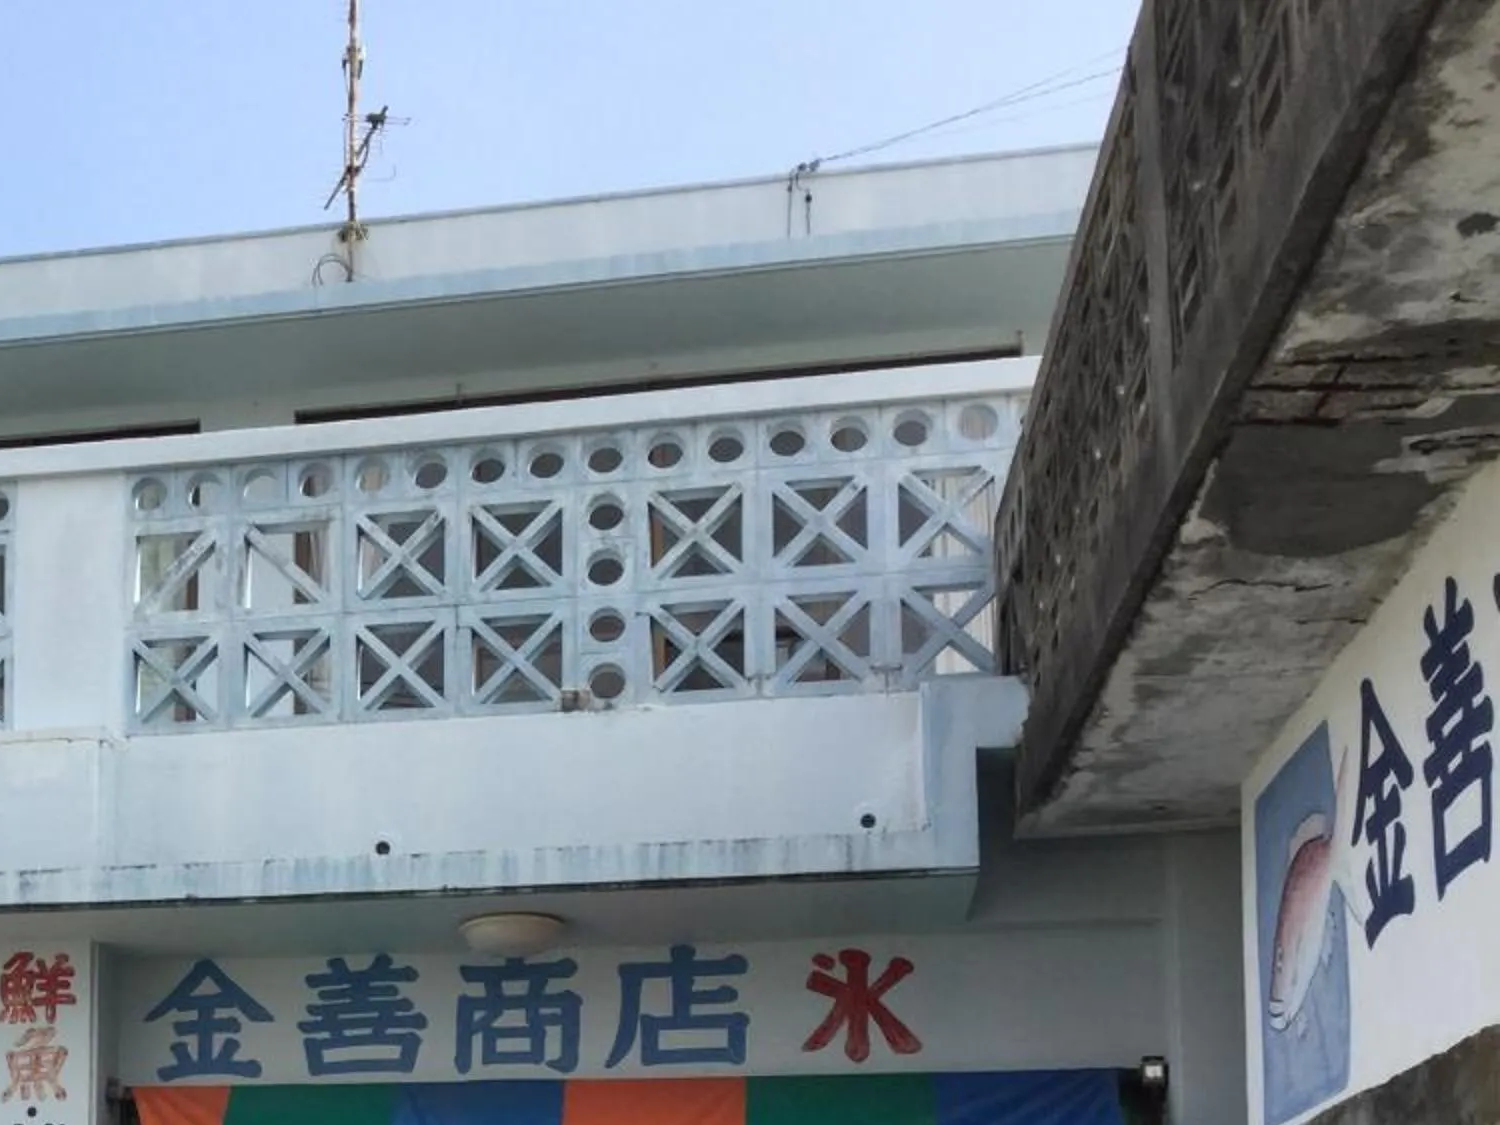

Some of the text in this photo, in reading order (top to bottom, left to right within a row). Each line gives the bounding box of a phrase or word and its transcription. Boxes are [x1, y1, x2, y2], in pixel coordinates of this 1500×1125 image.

[1352, 573, 1500, 950] 金善
[144, 944, 923, 1082] 金善商店 氷
